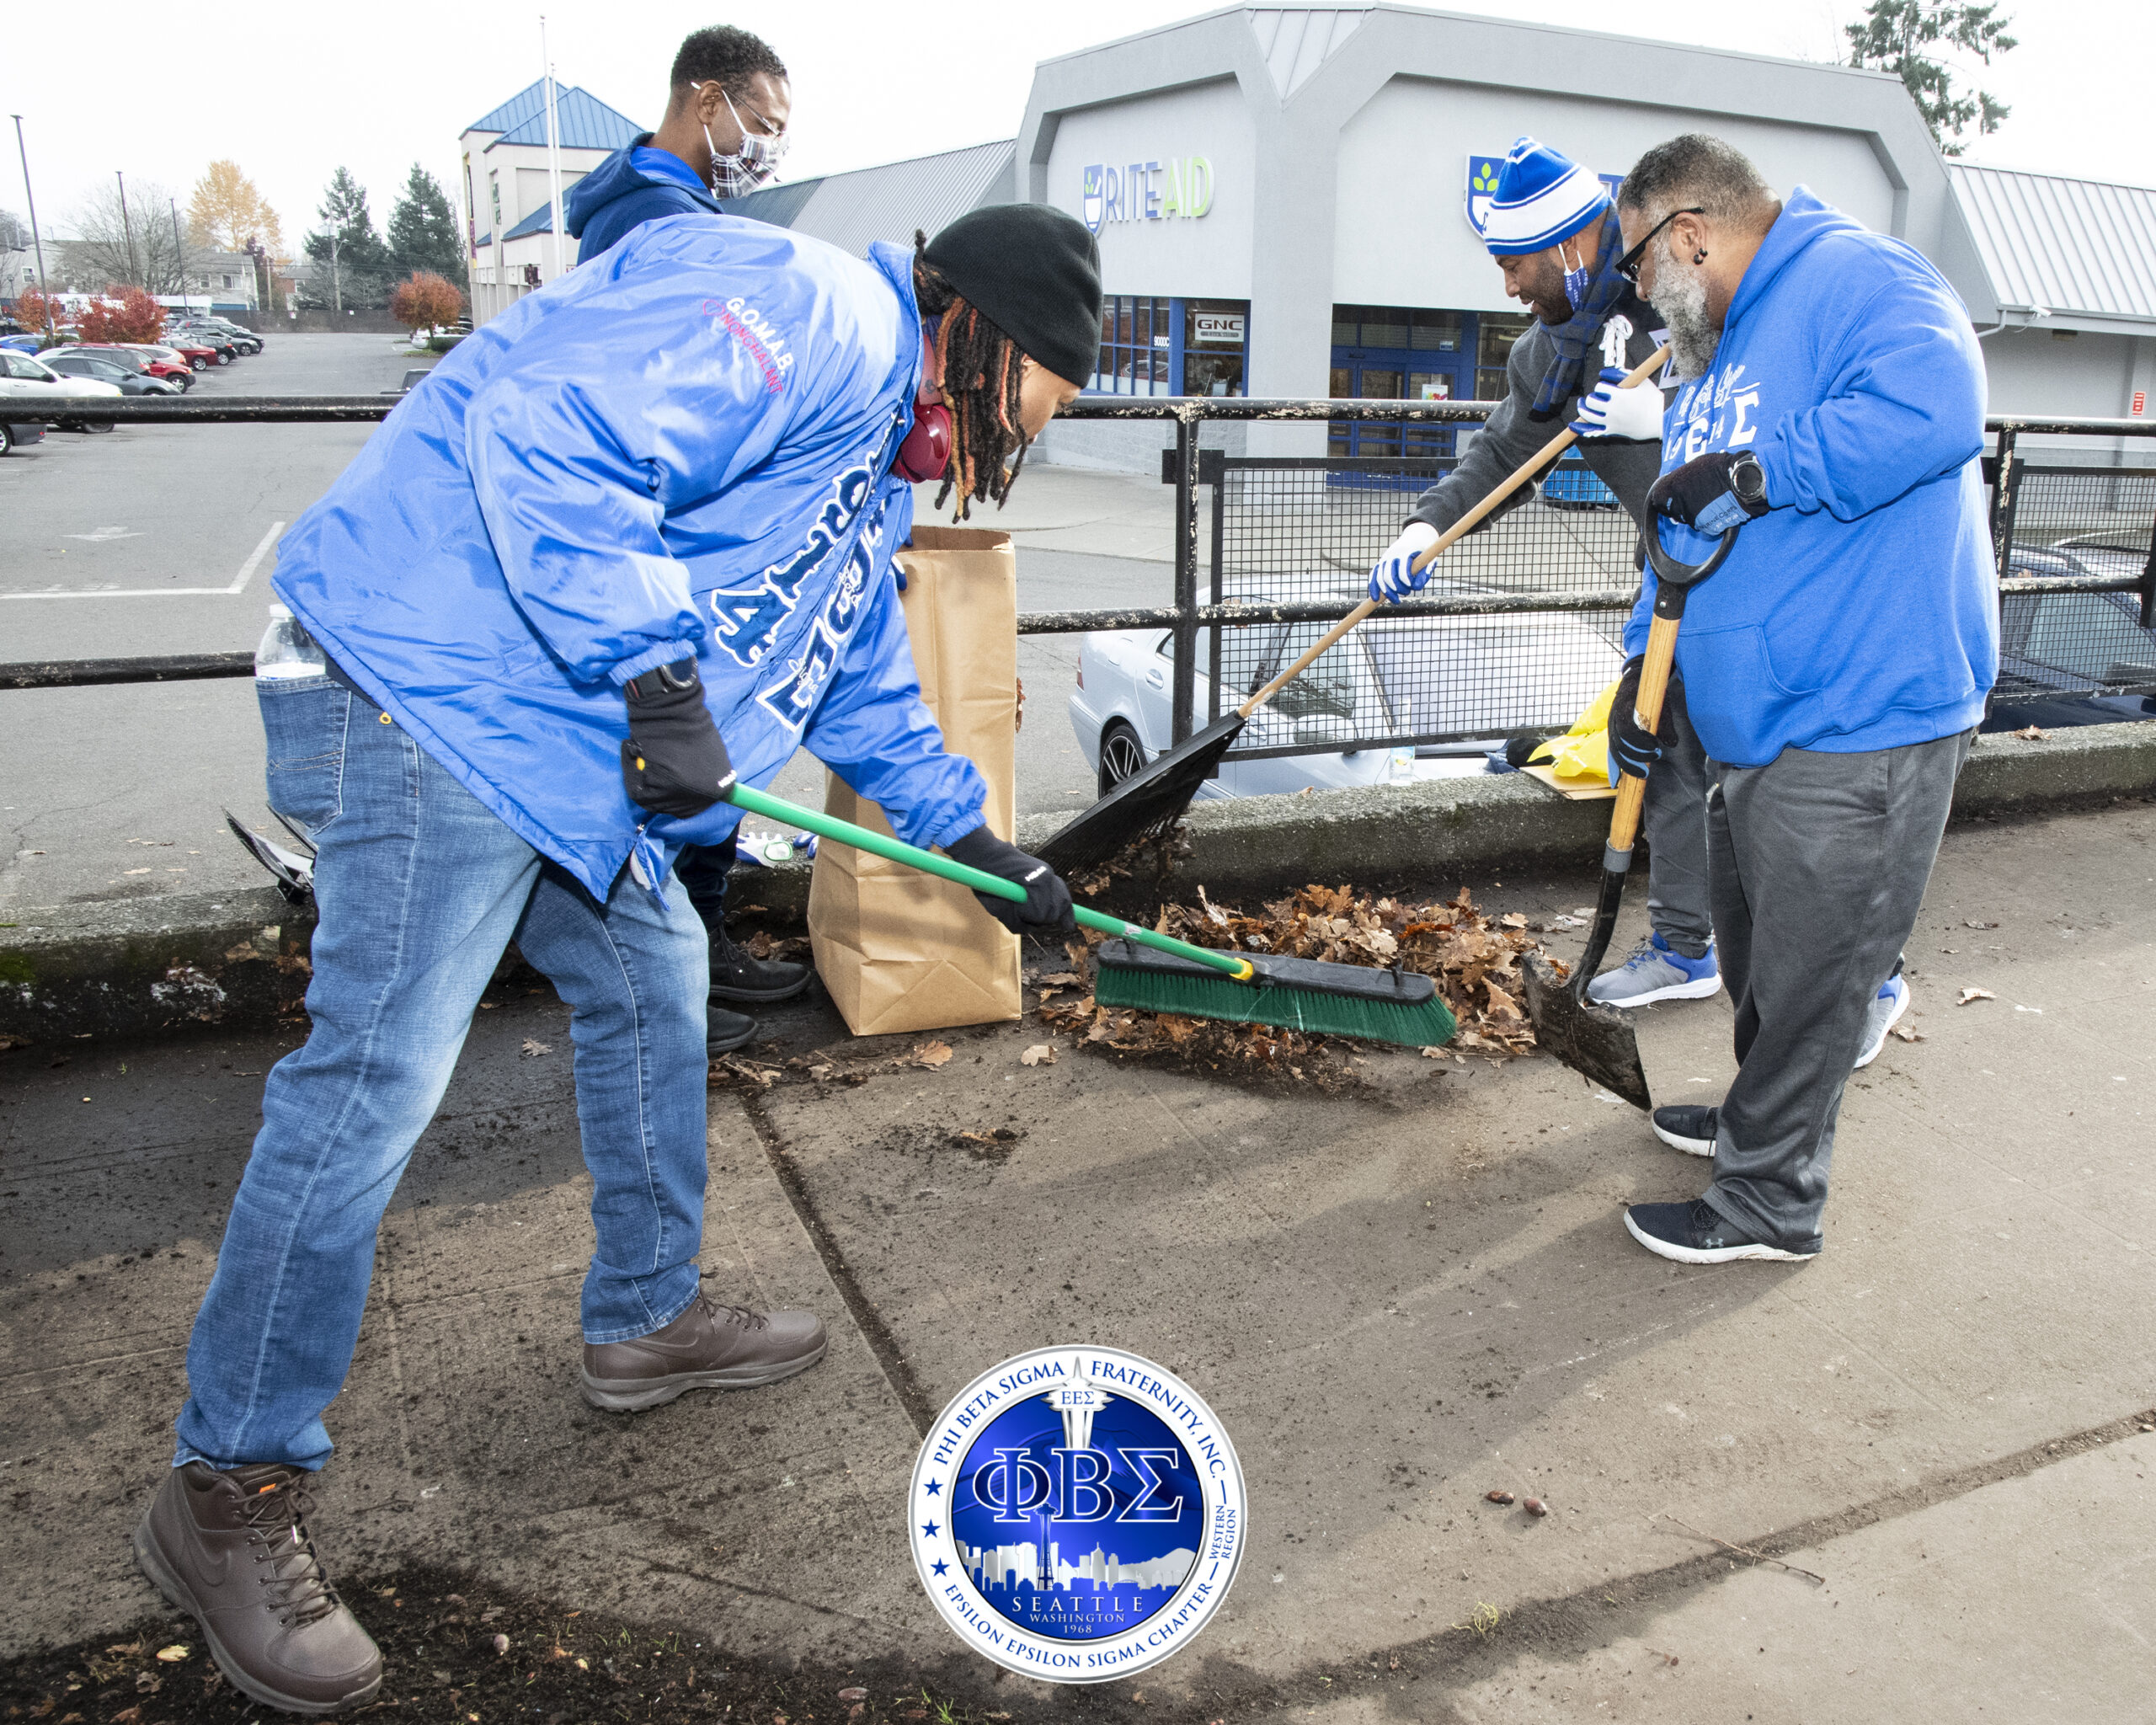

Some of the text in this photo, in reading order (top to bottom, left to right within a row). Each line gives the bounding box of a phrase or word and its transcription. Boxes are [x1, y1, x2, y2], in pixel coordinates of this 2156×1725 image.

[1106, 156, 1214, 222] RITE AID
[720, 312, 783, 394] NONCHALANT
[726, 297, 794, 376] G.O.M.A.B.
[1197, 319, 1243, 331] GNC
